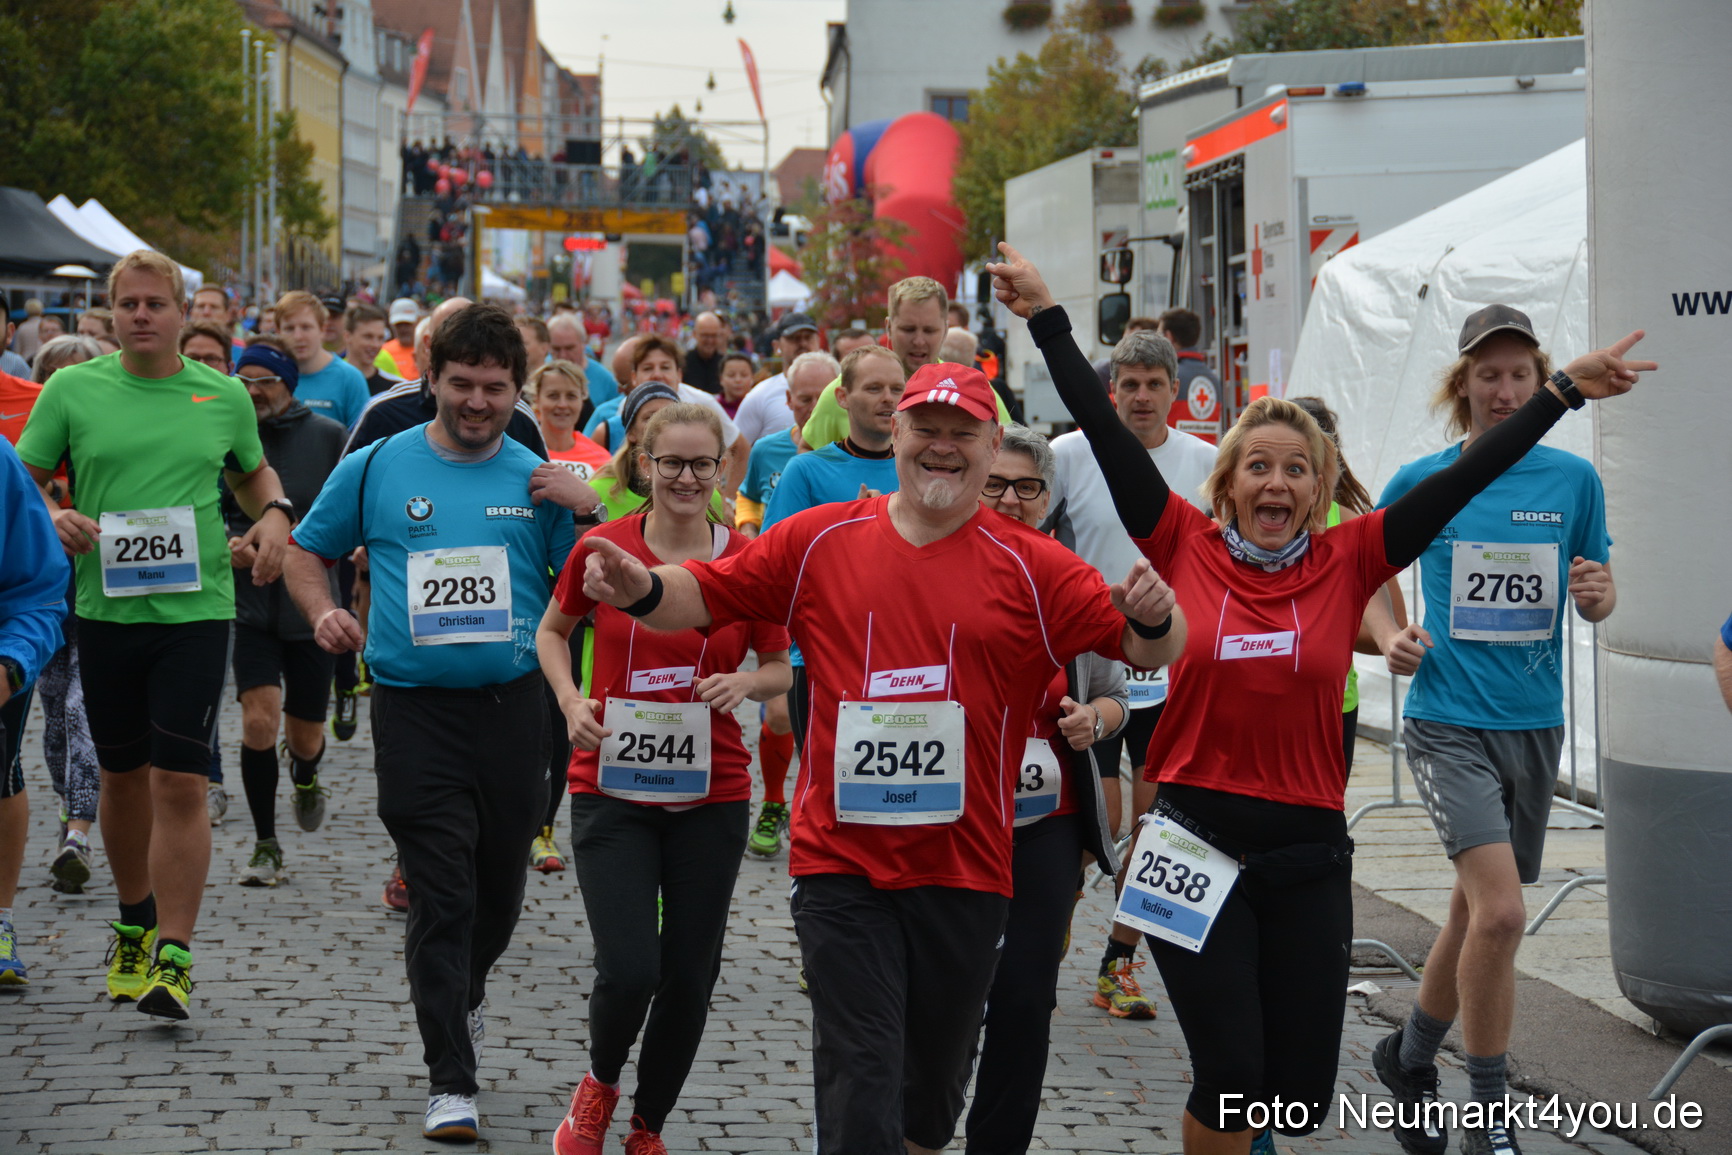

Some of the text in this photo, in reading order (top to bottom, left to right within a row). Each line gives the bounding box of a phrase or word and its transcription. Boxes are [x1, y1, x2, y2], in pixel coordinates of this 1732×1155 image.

[485, 505, 536, 519] BOCK
[1511, 510, 1564, 523] BOCK
[408, 524, 437, 533] PARTL
[114, 533, 184, 562] 2264
[445, 555, 481, 566] BOCK
[1493, 552, 1530, 561] BOCK
[137, 571, 165, 580] Manu
[423, 576, 496, 607] 2283
[1467, 572, 1543, 603] 2763
[438, 615, 485, 627] Christian
[1240, 640, 1274, 651] DEHN
[648, 673, 676, 685] DEHN
[889, 674, 925, 688] DEHN
[646, 711, 682, 721] BOCK
[883, 713, 927, 725] BOCK
[617, 731, 695, 764] 2544
[854, 740, 945, 777] 2542
[634, 773, 674, 785] Paulina
[882, 790, 917, 804] Josef
[1169, 832, 1209, 859] BOCK
[1136, 850, 1211, 903] 2538
[1140, 898, 1173, 920] Nadine
